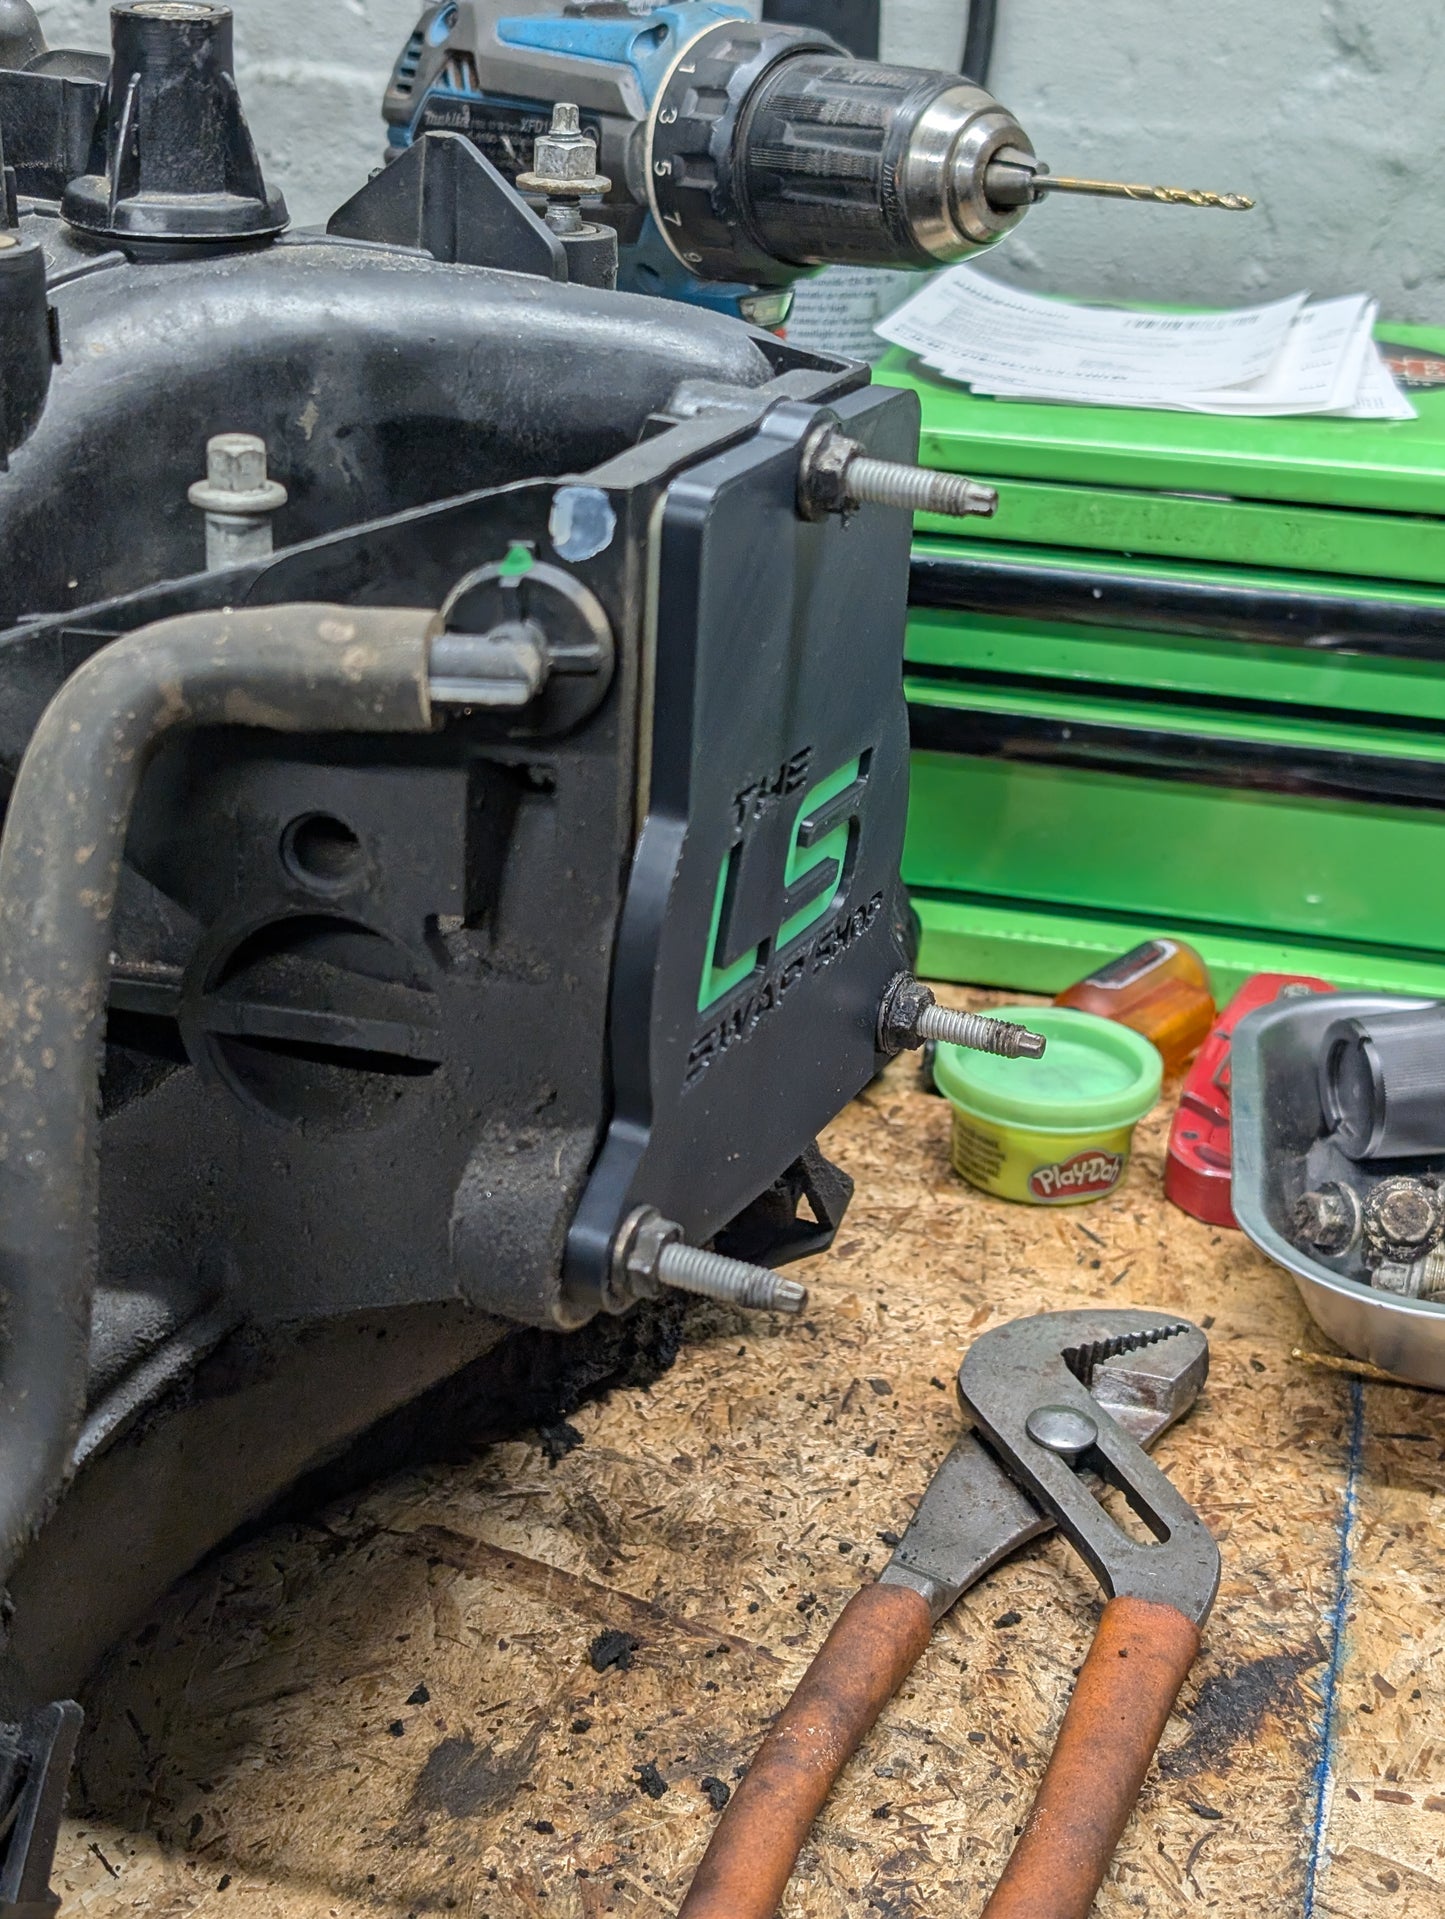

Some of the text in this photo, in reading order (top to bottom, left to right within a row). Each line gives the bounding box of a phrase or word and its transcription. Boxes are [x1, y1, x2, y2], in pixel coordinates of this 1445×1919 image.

[658, 107, 678, 124] 3
[654, 160, 672, 177] 5
[663, 211, 682, 227] 7
[733, 746, 814, 832] THE
[698, 747, 873, 1013] LS
[683, 956, 806, 1085] SWAP
